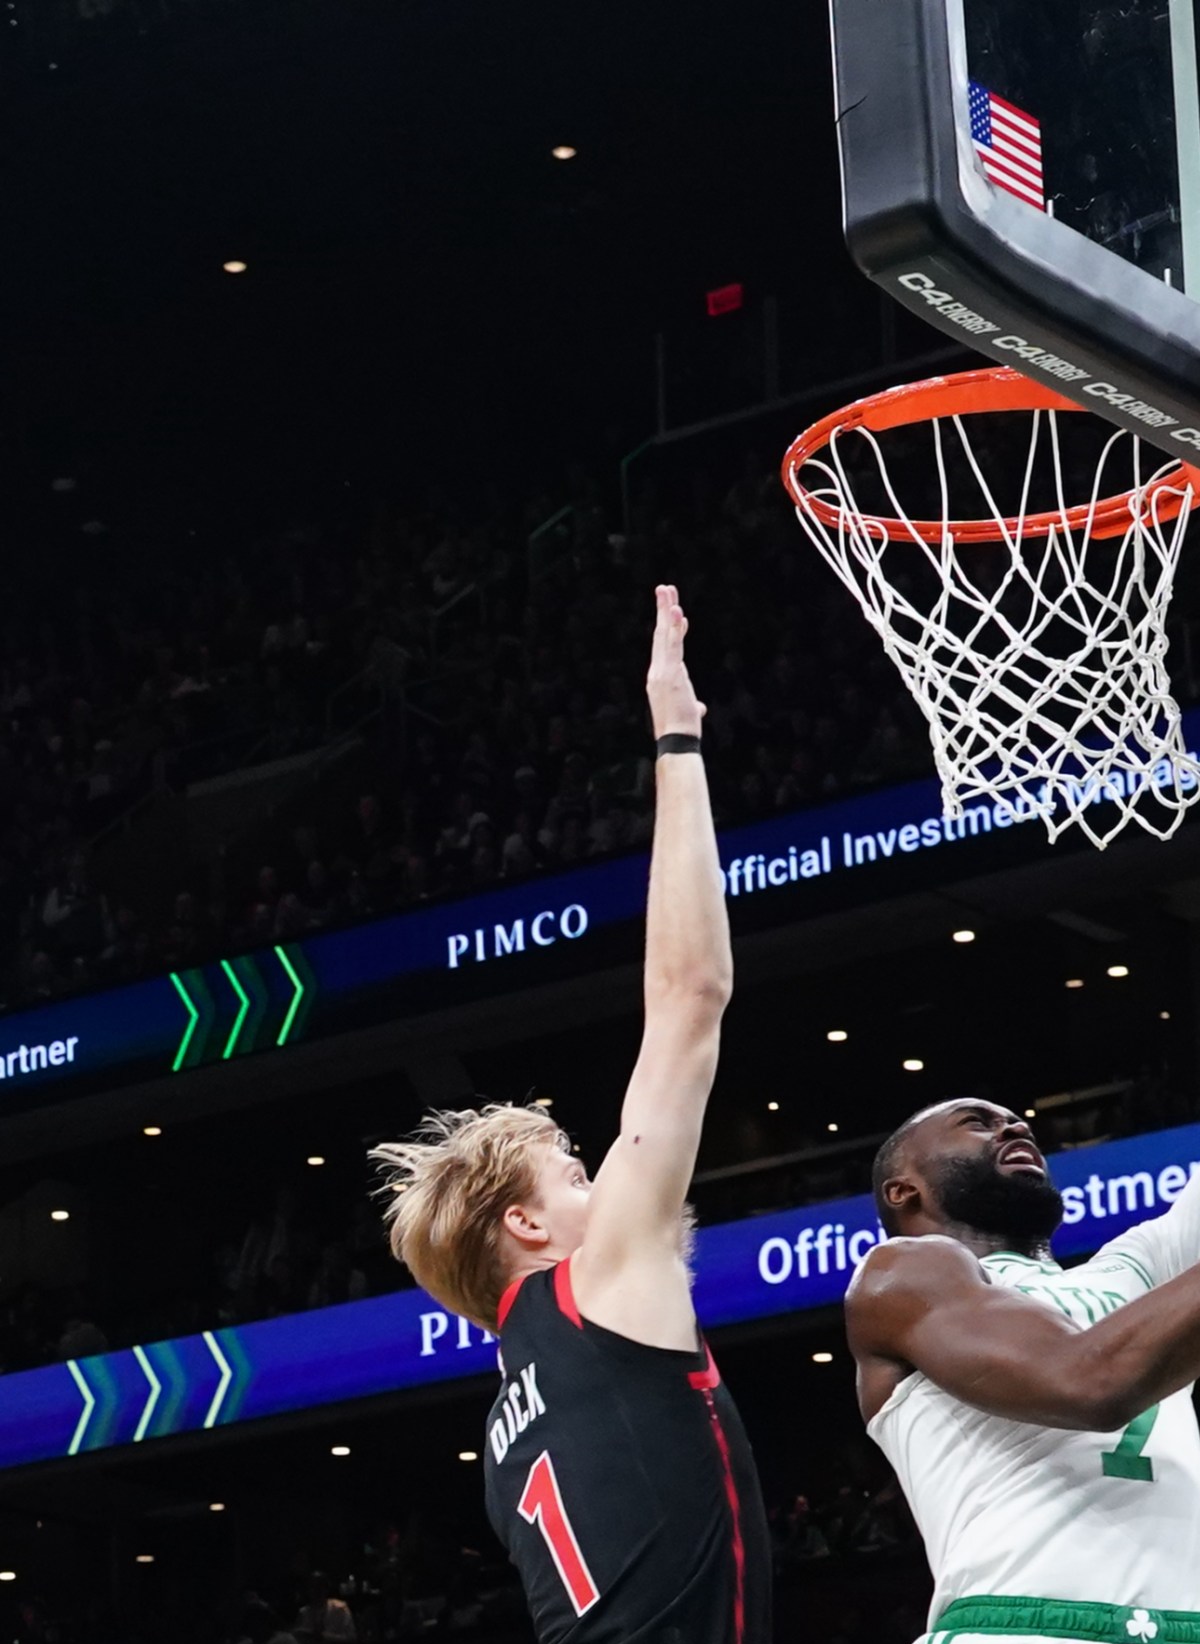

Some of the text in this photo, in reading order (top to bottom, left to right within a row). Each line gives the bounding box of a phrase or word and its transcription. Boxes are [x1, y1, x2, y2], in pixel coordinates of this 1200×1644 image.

[447, 903, 589, 969] PIMCO
[489, 1362, 546, 1466] DICK
[517, 1449, 601, 1619] 1
